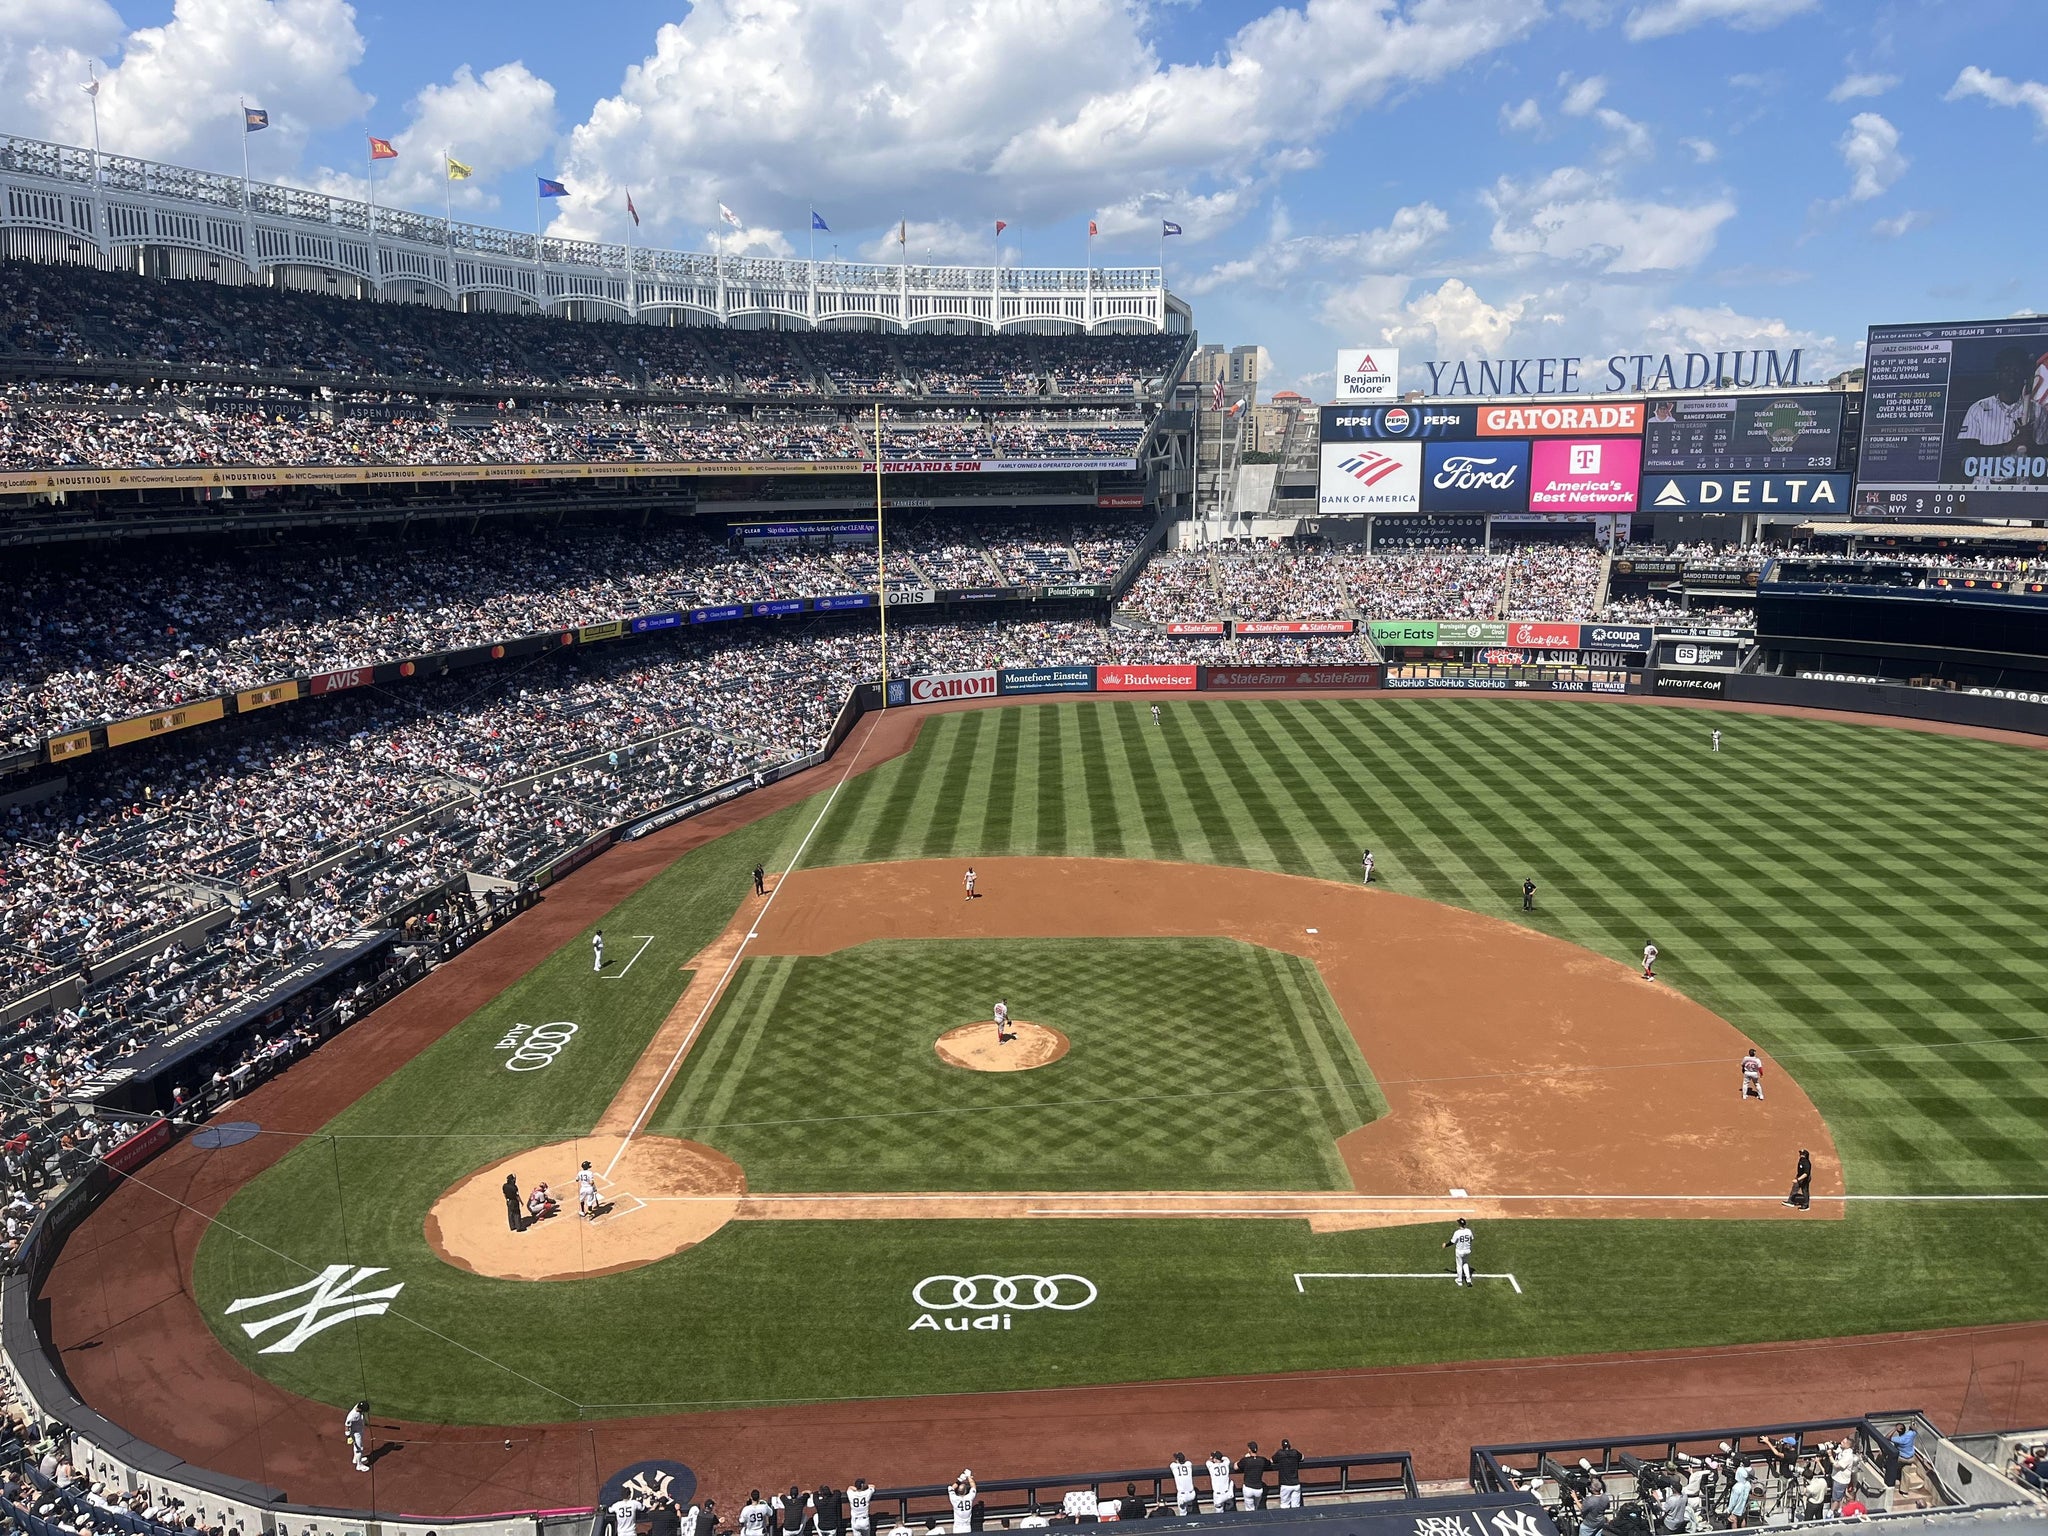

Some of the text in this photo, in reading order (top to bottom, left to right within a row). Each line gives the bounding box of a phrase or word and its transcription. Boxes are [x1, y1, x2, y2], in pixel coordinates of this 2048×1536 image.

[1426, 348, 1805, 396] YANKEE STADIUM
[1344, 374, 1390, 386] Benjamin
[1350, 384, 1382, 394] Moore
[214, 403, 304, 414] ASPEN VODKA
[351, 408, 424, 418] ASPEN VODKA
[1336, 416, 1372, 426] PEPSI
[1386, 416, 1408, 426] PEPSI
[1424, 416, 1460, 426] PEPSI
[1486, 408, 1635, 430] GATORADE
[882, 462, 980, 472] RICHARD & SON
[1808, 457, 1832, 466] 2:33
[1964, 456, 2048, 478] CHISHO
[222, 473, 276, 481] INDUSTRIOUS
[1434, 456, 1518, 490] Ford
[56, 476, 110, 485] INDUSTRIOUS
[142, 474, 203, 484] Coworking Locations
[1546, 480, 1622, 492] America's
[1533, 491, 1634, 502] Best Network
[1701, 480, 1836, 504] DELTA
[1112, 498, 1142, 506] Budweiser
[1321, 496, 1349, 504] BANK
[1890, 494, 1908, 502] BOS
[1916, 499, 1924, 508] 3
[1048, 586, 1094, 597] Poland Spring
[889, 592, 924, 604] ORIS
[1404, 629, 1434, 640] Eats
[1516, 628, 1569, 646] Chick-fil-A
[1607, 631, 1640, 642] coupa
[1551, 651, 1578, 664] SUB
[1582, 652, 1627, 667] ABOVE
[1679, 650, 1694, 658] GS
[326, 670, 359, 690] AVIS
[1006, 672, 1088, 683] Montefiore Einstein
[1124, 674, 1192, 686] Budweiser
[912, 676, 994, 700] Canon
[1388, 679, 1506, 688] StubHub StubHub StubHub
[1552, 682, 1584, 690] STARR
[1658, 678, 1721, 690] NITTOTIRE.COM
[252, 687, 282, 704] COOK UNITY
[150, 712, 186, 732] COOK UNITY
[52, 737, 88, 756] COOK UNITY
[274, 962, 324, 988] Welcome
[216, 990, 270, 1018] Yankee
[162, 1018, 221, 1048] Stadium
[494, 1023, 532, 1049] Audi
[580, 1174, 588, 1182] 13
[224, 1264, 405, 1354] NY
[908, 1314, 1011, 1330] Audi
[1178, 1466, 1188, 1476] 19
[1214, 1466, 1227, 1476] 30
[853, 1498, 866, 1508] 84
[958, 1500, 971, 1512] 48
[618, 1506, 632, 1518] 35
[750, 1513, 763, 1522] 39
[1415, 1516, 1461, 1531] NEW
